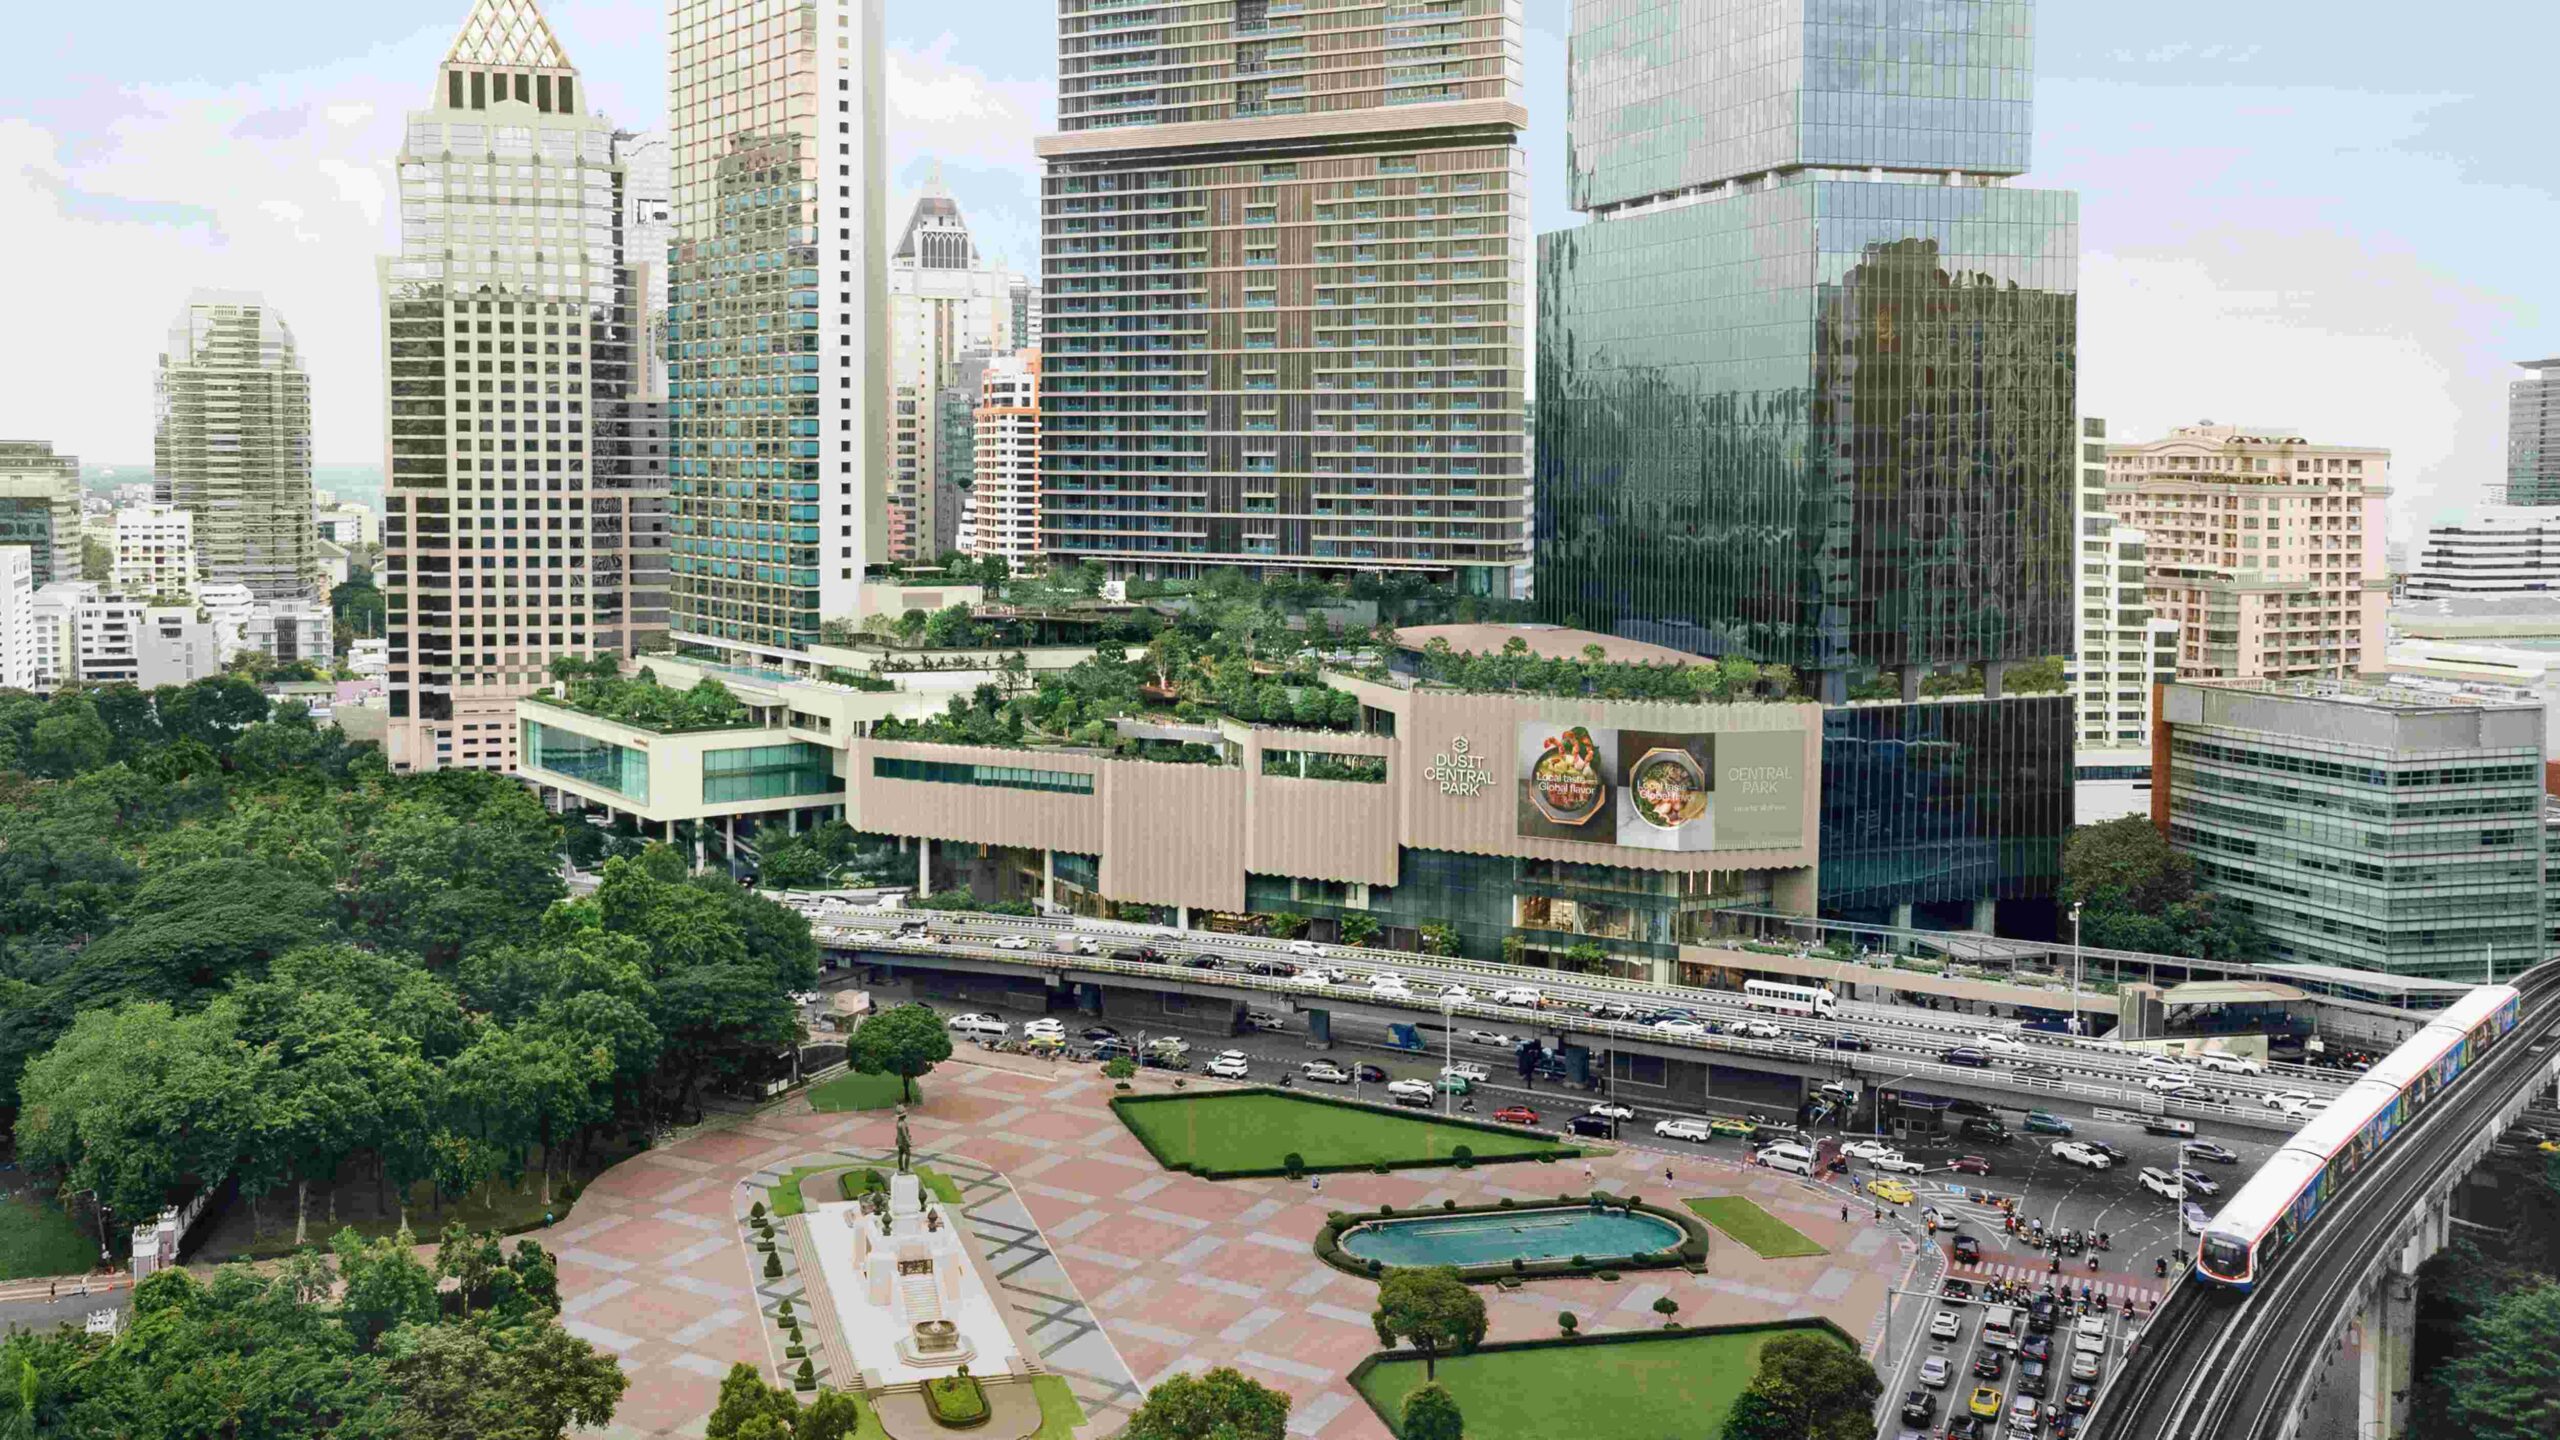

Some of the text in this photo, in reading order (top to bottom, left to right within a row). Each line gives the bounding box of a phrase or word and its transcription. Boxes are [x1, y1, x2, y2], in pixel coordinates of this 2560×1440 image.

[1436, 753, 1485, 769] DUSIT
[1424, 766, 1497, 785] CENTRAL
[1536, 772, 1586, 783] Local taste
[1728, 766, 1793, 781] CENTRAL
[1440, 781, 1480, 797] PARK
[1539, 782, 1596, 795] Global flavor
[1742, 781, 1778, 794] PARK
